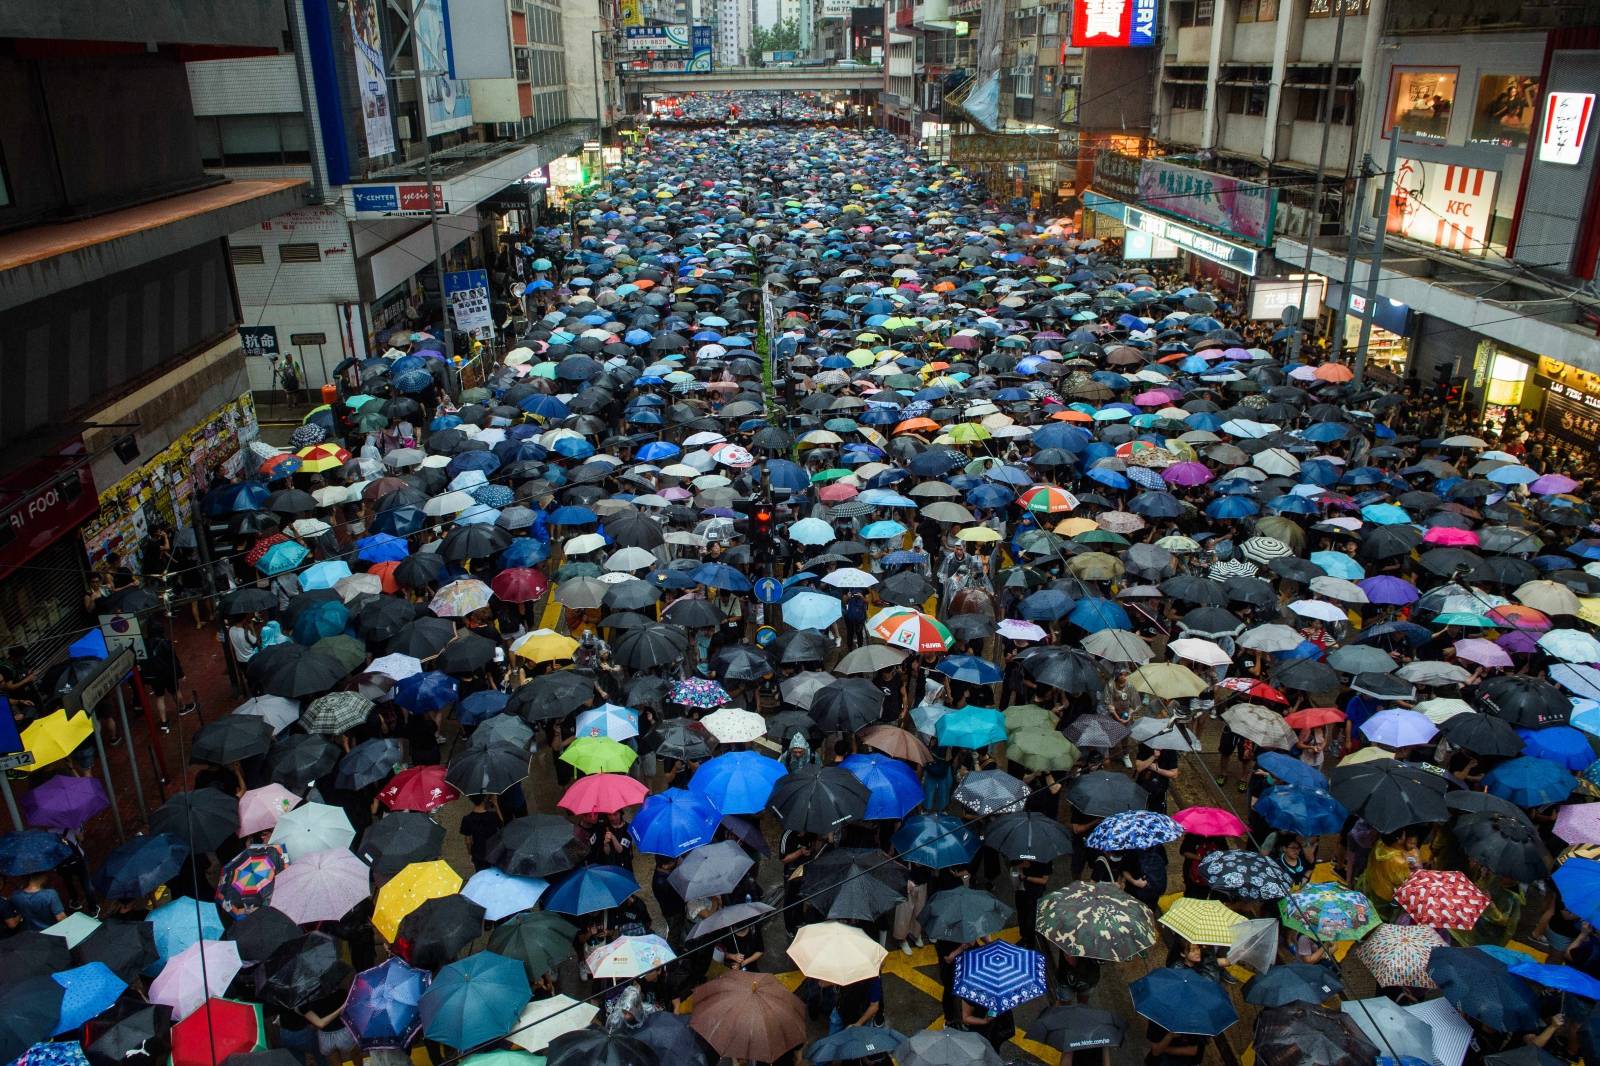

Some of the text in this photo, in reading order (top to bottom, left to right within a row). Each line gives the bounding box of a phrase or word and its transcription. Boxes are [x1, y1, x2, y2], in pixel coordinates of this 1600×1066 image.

[357, 193, 395, 201] Y-CENTER
[1446, 200, 1472, 216] KFC
[1551, 381, 1564, 393] LAO
